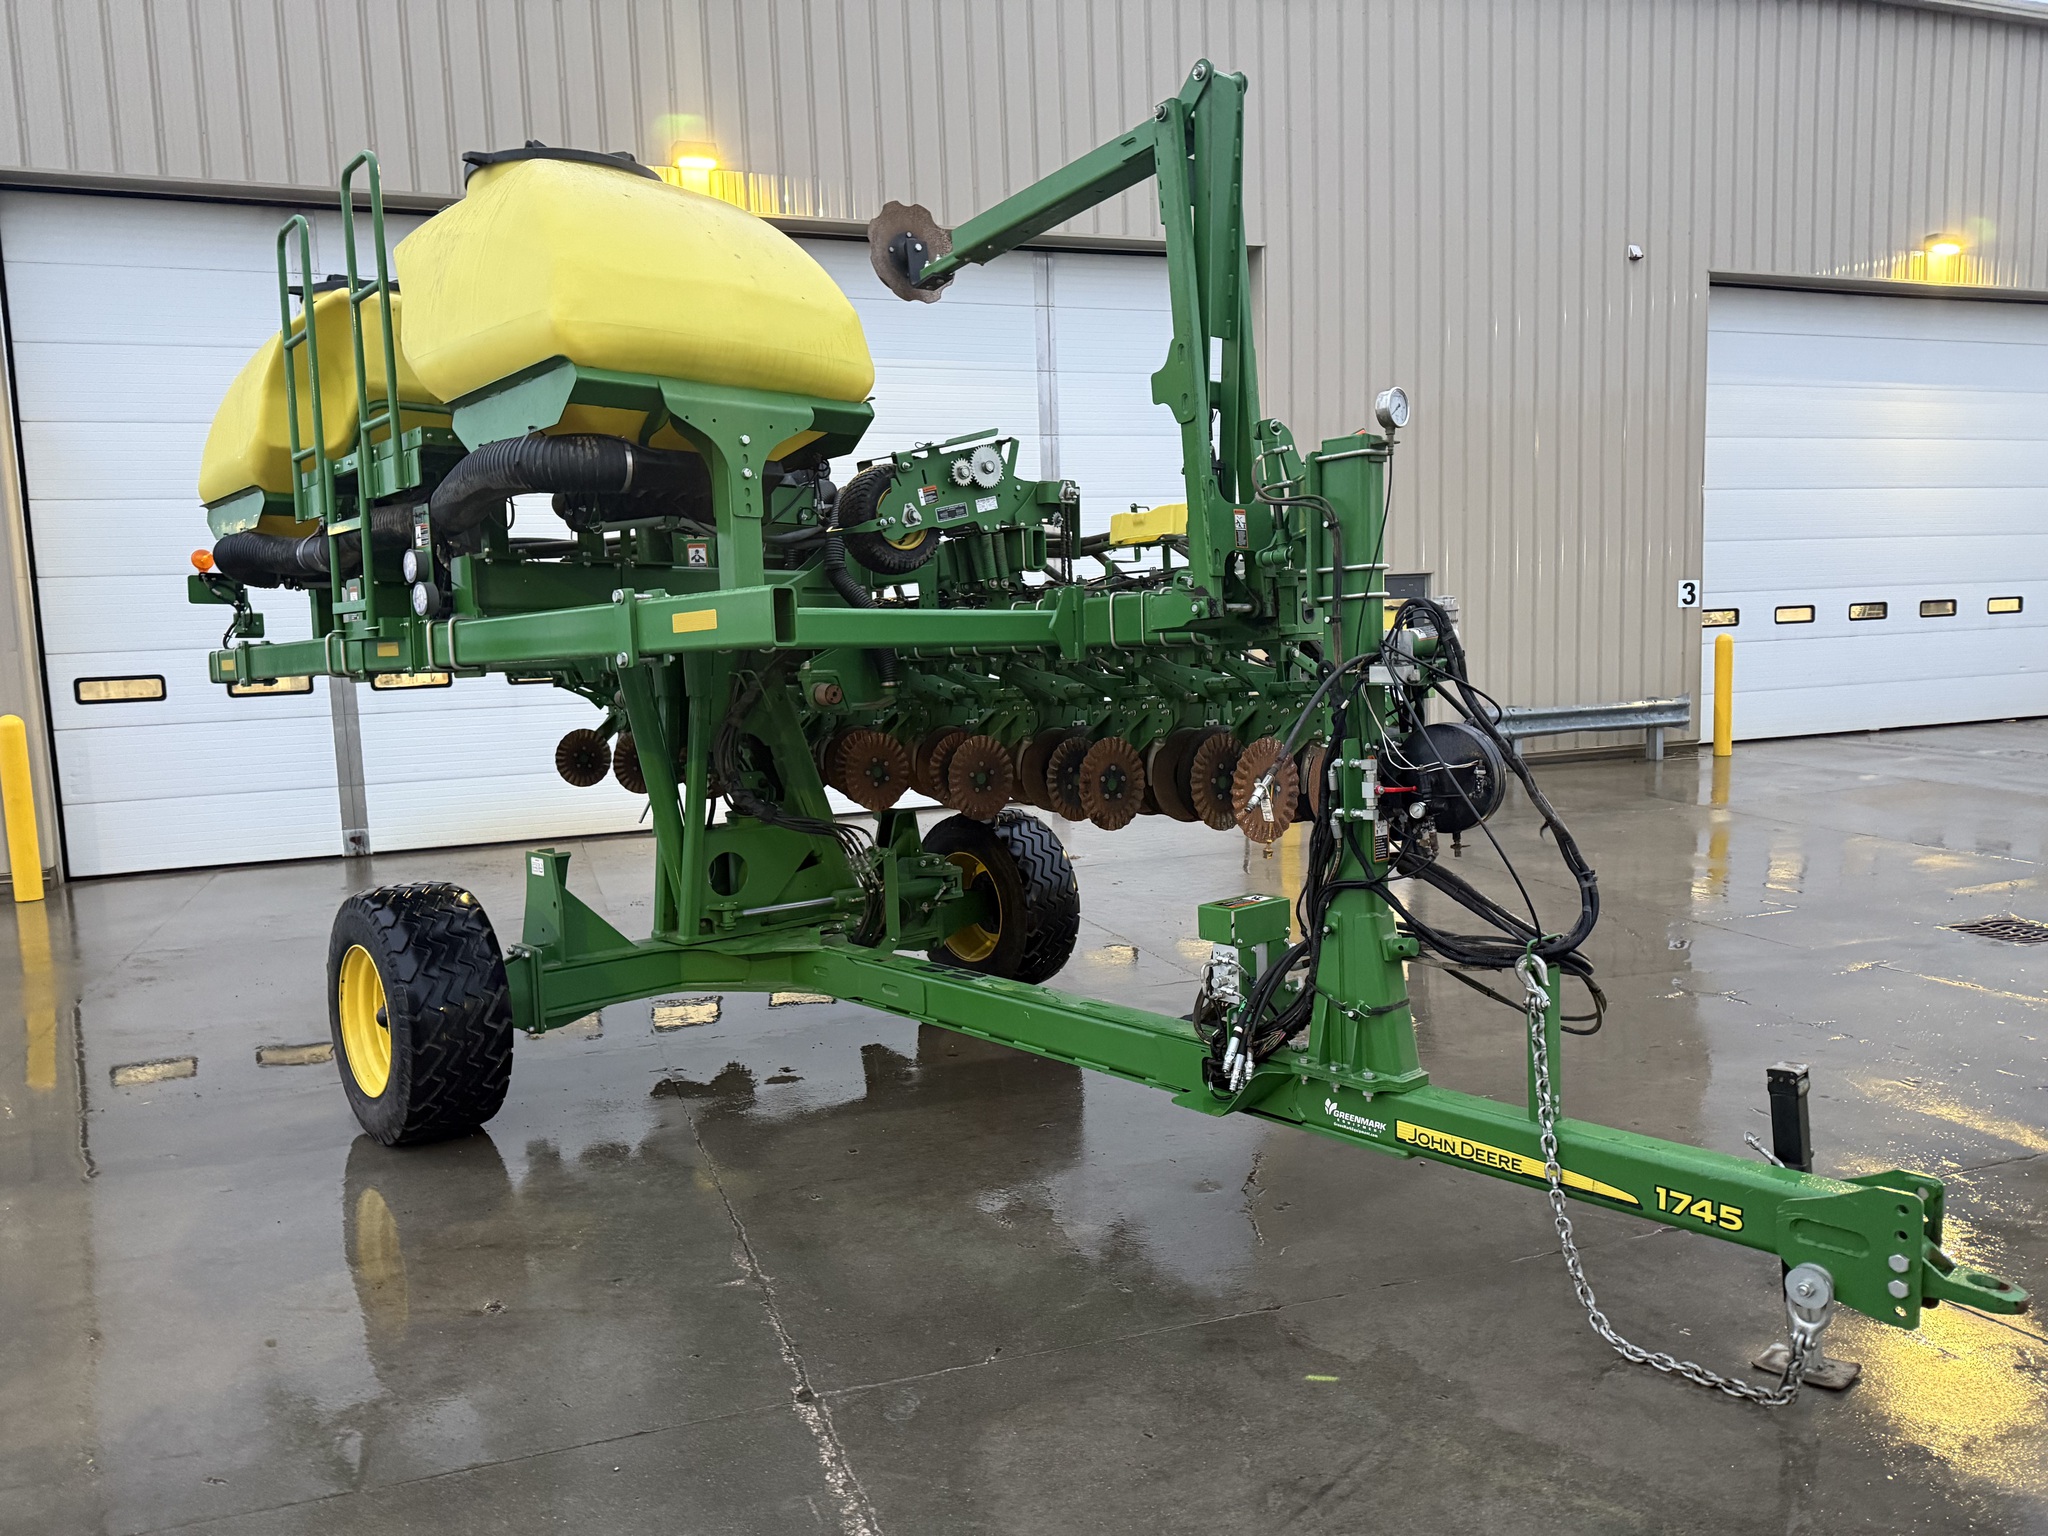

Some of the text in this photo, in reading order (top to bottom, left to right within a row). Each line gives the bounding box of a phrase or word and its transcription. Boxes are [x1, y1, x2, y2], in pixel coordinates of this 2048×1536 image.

[1682, 582, 1696, 605] 3
[1333, 1109, 1387, 1131] GREENMARK
[1408, 1128, 1523, 1172] JOHN DEERE
[1655, 1186, 1743, 1231] 1745
